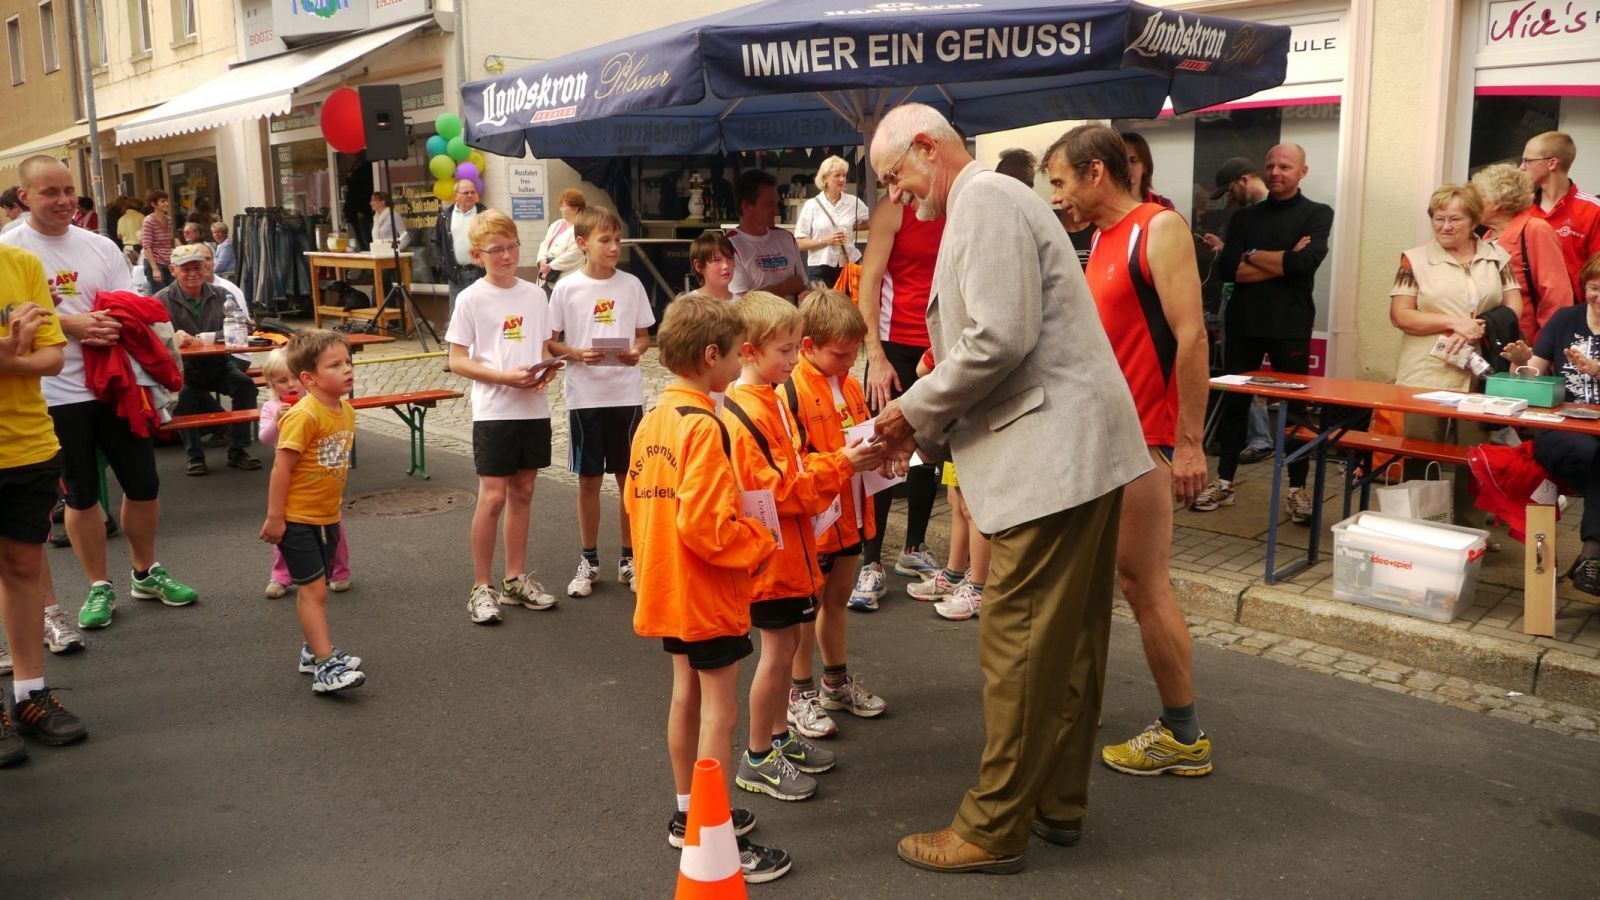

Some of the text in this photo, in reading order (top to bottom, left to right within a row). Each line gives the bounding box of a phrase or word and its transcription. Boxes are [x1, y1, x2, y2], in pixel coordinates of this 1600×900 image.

[1490, 1, 1587, 41] Nick's
[249, 29, 273, 46] BOOTS
[1124, 11, 1227, 57] Landskron
[1293, 37, 1337, 52] ULE
[741, 21, 1093, 77] IMMER EIN GENUSS!
[475, 51, 672, 126] Landskron Pilsner
[55, 271, 78, 286] ASV
[593, 300, 615, 315] ASV
[503, 316, 523, 332] ASV
[758, 500, 767, 527] Urkun
